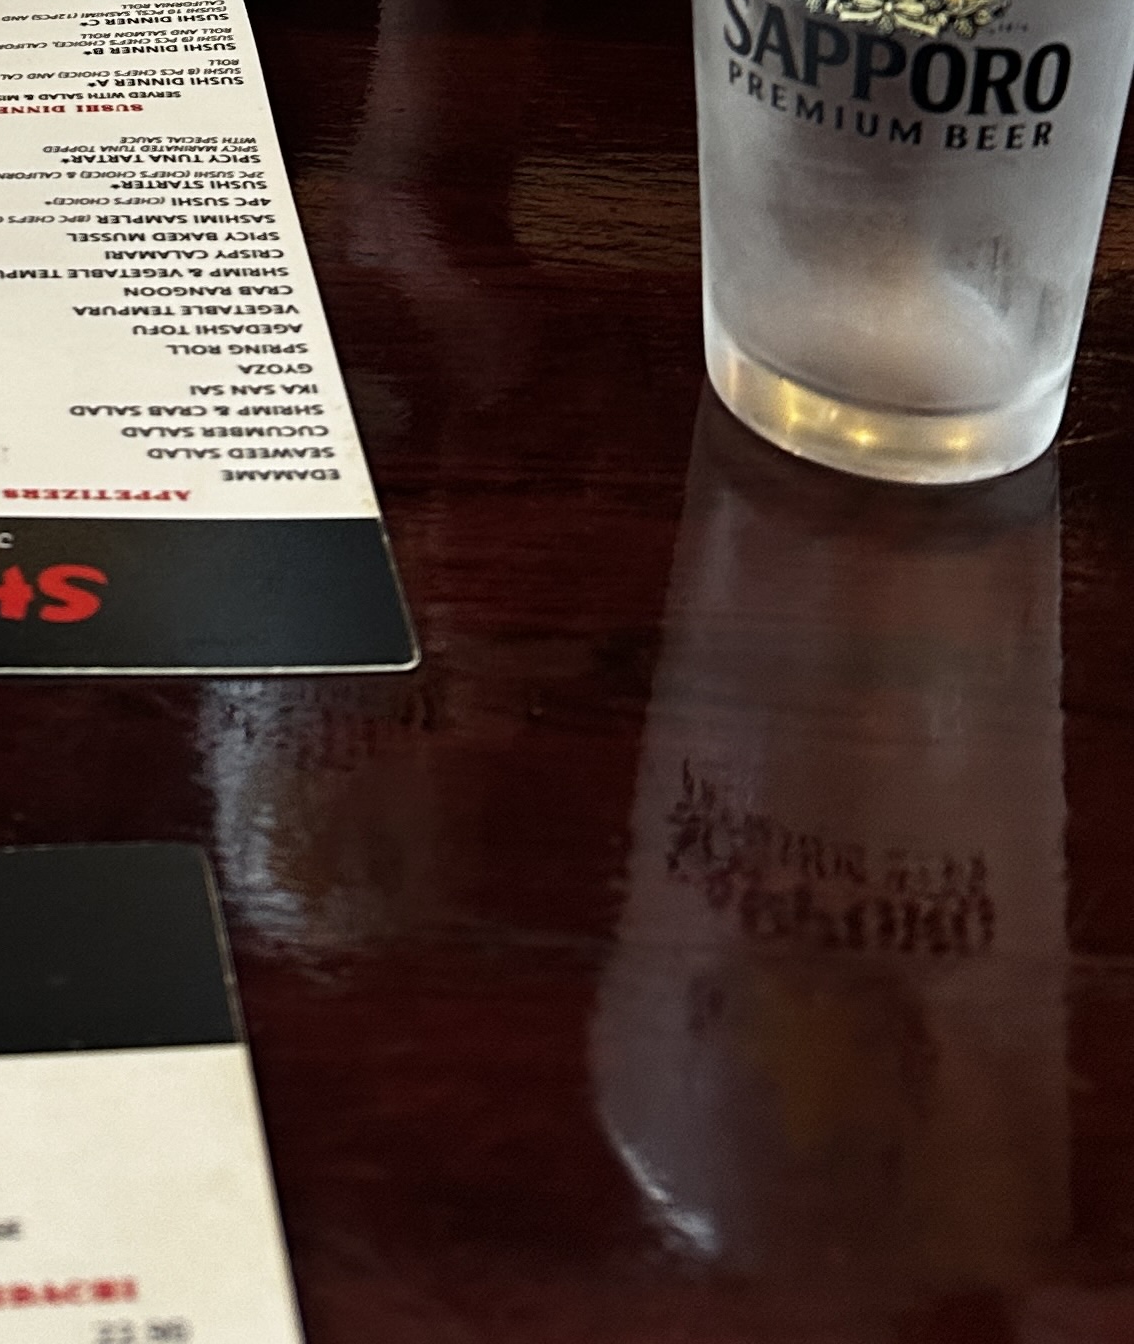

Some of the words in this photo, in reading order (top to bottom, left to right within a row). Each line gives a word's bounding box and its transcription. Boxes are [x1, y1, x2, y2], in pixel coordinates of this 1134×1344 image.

[75, 104, 144, 112] SUSHI
[728, 59, 923, 146] PREMIUM
[944, 120, 1054, 152] BEER
[147, 154, 205, 163] TUNA
[208, 154, 262, 163] SPICY
[209, 181, 268, 189] SUSHI
[170, 197, 230, 206] SUSHI
[233, 197, 272, 206] 4PC
[95, 215, 189, 224] SAMPLER
[192, 215, 276, 223] SASHIMI
[66, 233, 147, 242] MUSSEL
[151, 232, 219, 241] BAKED
[224, 232, 281, 241] SPICY
[104, 250, 209, 260] CALAMARI
[214, 249, 285, 259] CRISPY
[67, 268, 184, 278] VEGETABLE
[187, 268, 204, 278] &
[208, 267, 290, 277] SHRIMP
[123, 287, 233, 296] RANGOON
[237, 285, 294, 295] CRAB
[72, 306, 176, 316] TEMPURA
[180, 305, 300, 315] VEGETABLE
[132, 325, 191, 335] TOFU
[195, 324, 304, 335] AGEDASHI
[165, 345, 222, 355] ROLL
[227, 343, 309, 355] SPRING
[237, 363, 314, 374] GYOZA
[189, 385, 225, 396] SAI
[230, 384, 277, 395] SAN
[280, 384, 319, 394] IKA
[68, 406, 143, 416] SALAD
[147, 406, 208, 416] CRAB
[213, 406, 231, 416] &
[236, 404, 325, 416] SHRIMP
[120, 427, 195, 437] SALAD
[200, 426, 330, 437] CUCUMBER
[146, 448, 222, 459] SALAD
[227, 447, 336, 459] SEAWEED
[221, 469, 341, 481] EDAMAME
[1, 489, 191, 501] APPETIZERS
